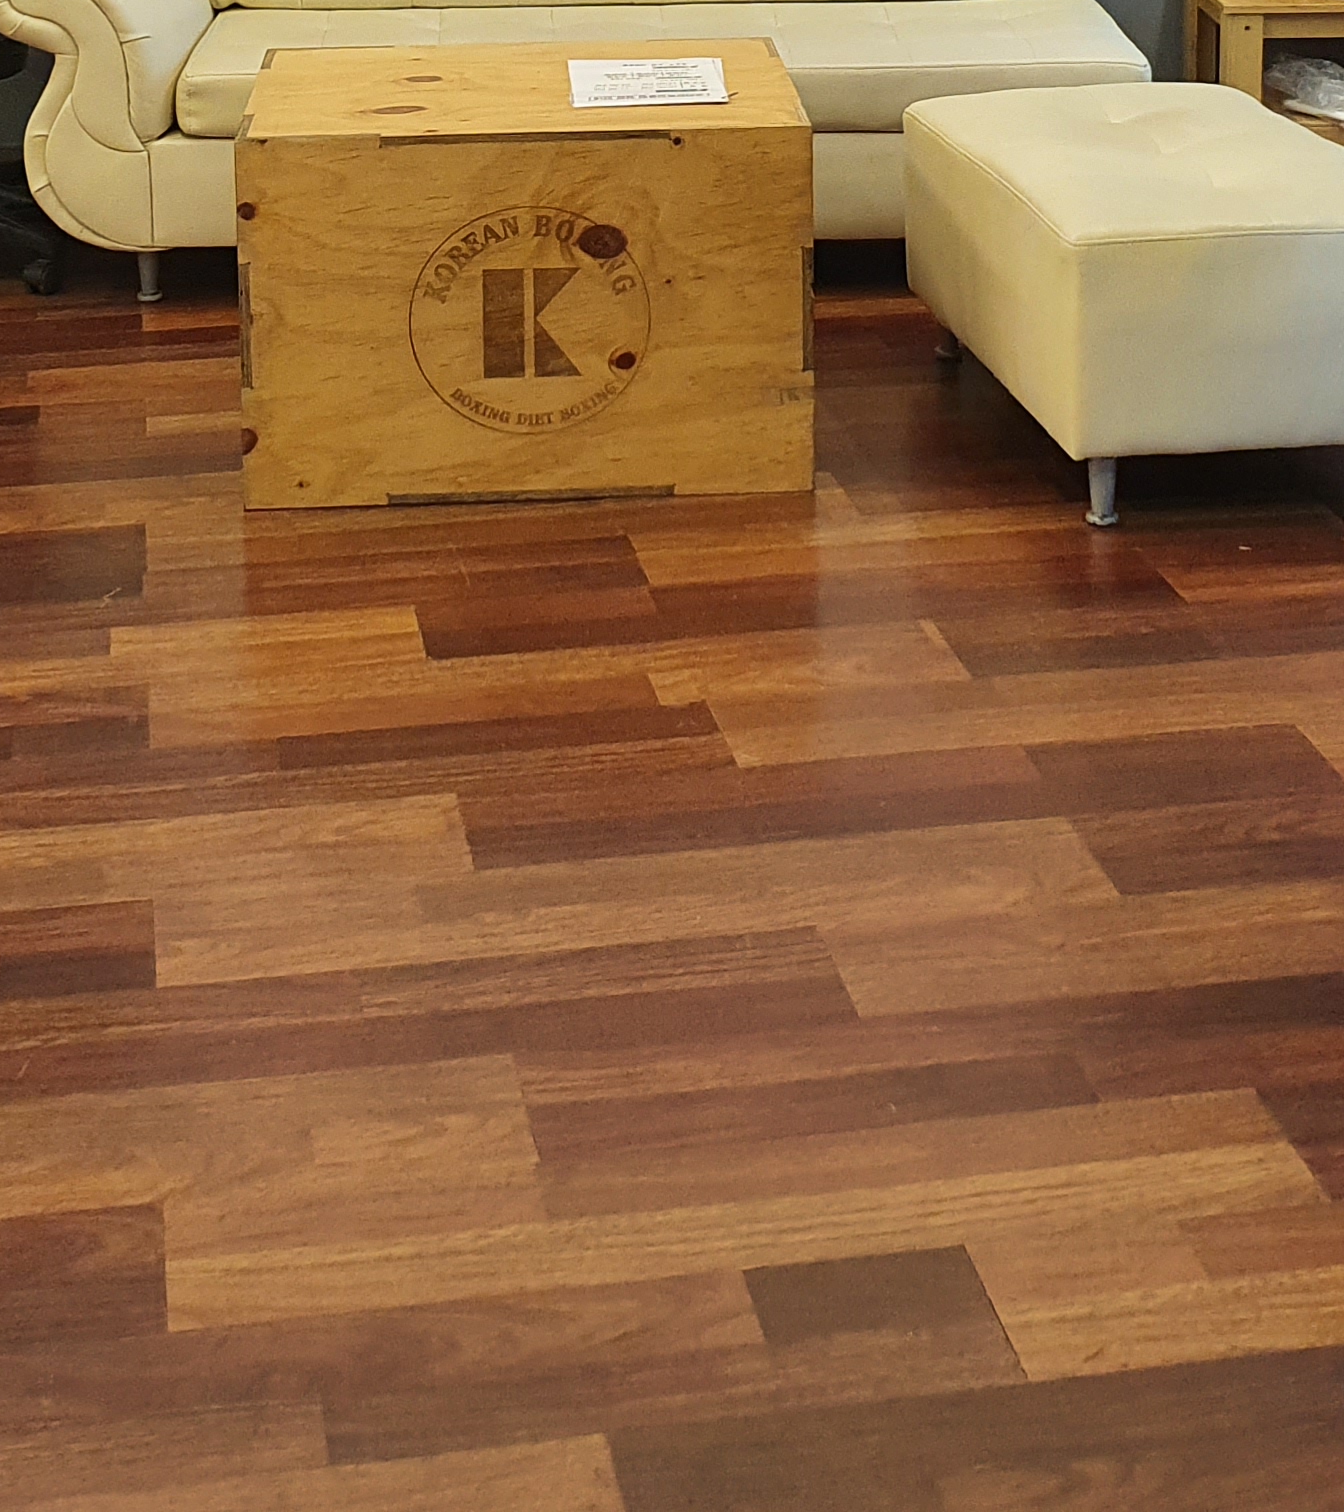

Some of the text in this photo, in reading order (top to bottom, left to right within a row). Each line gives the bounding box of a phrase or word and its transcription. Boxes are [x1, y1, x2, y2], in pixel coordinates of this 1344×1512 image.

[423, 214, 637, 305] KOREAN BONG
[449, 387, 511, 424] BOXING
